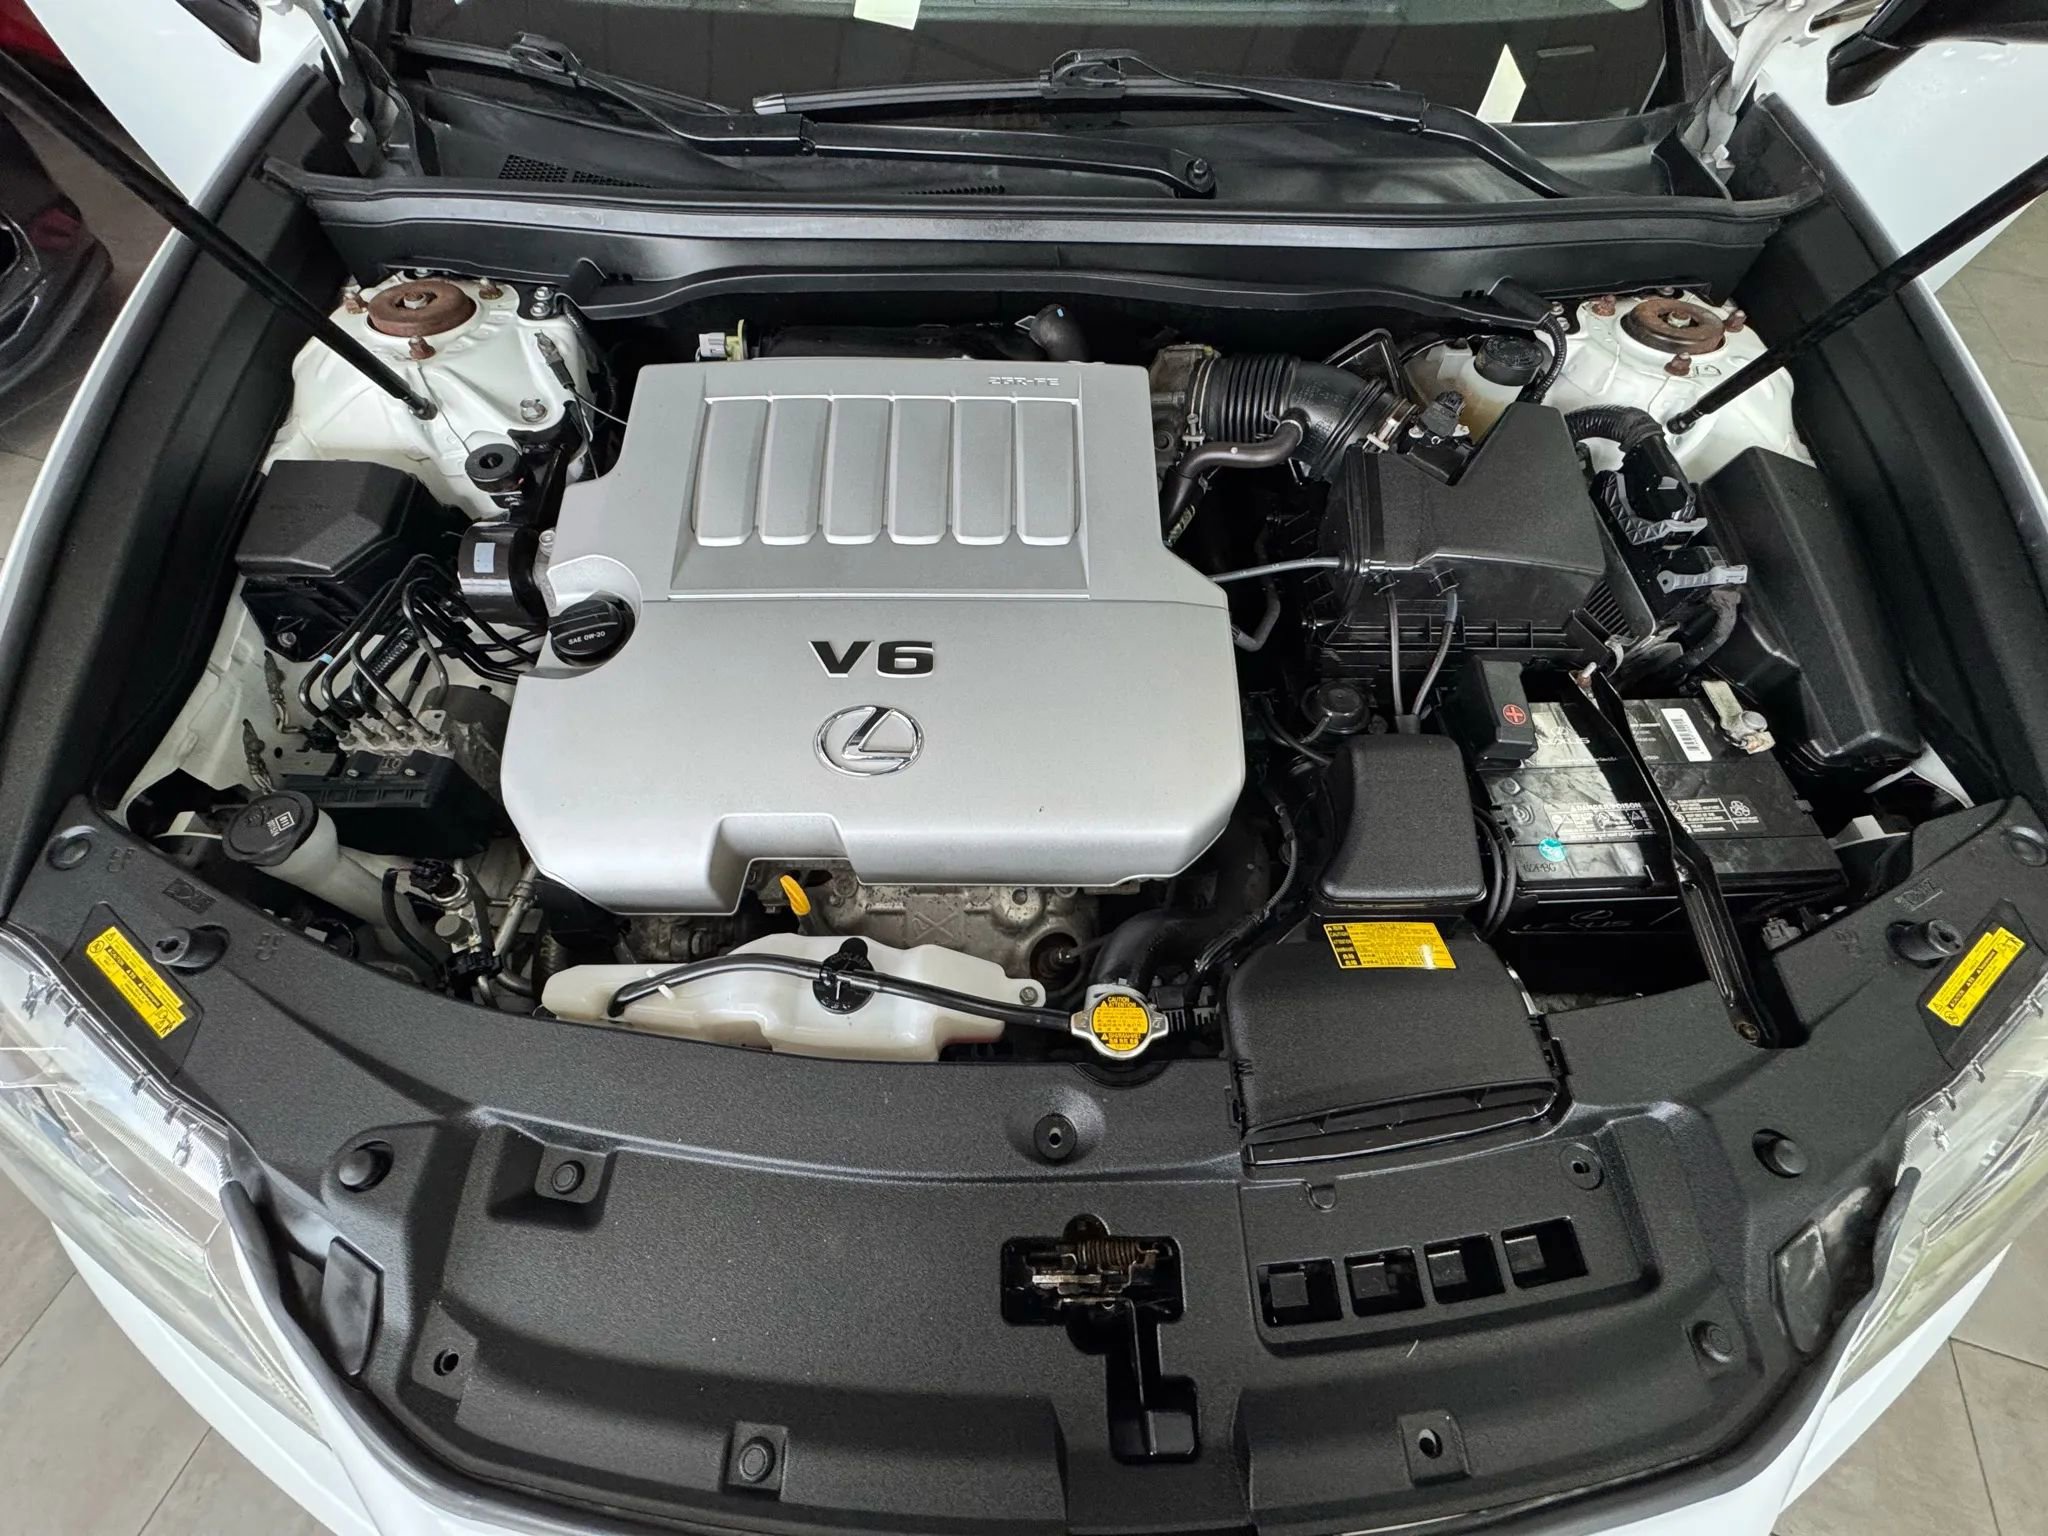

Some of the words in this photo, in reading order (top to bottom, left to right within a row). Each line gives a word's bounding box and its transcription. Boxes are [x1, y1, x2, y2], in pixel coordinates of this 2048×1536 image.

[568, 636, 582, 645] SAE
[584, 631, 606, 640] 0W-20
[808, 640, 935, 679] V6
